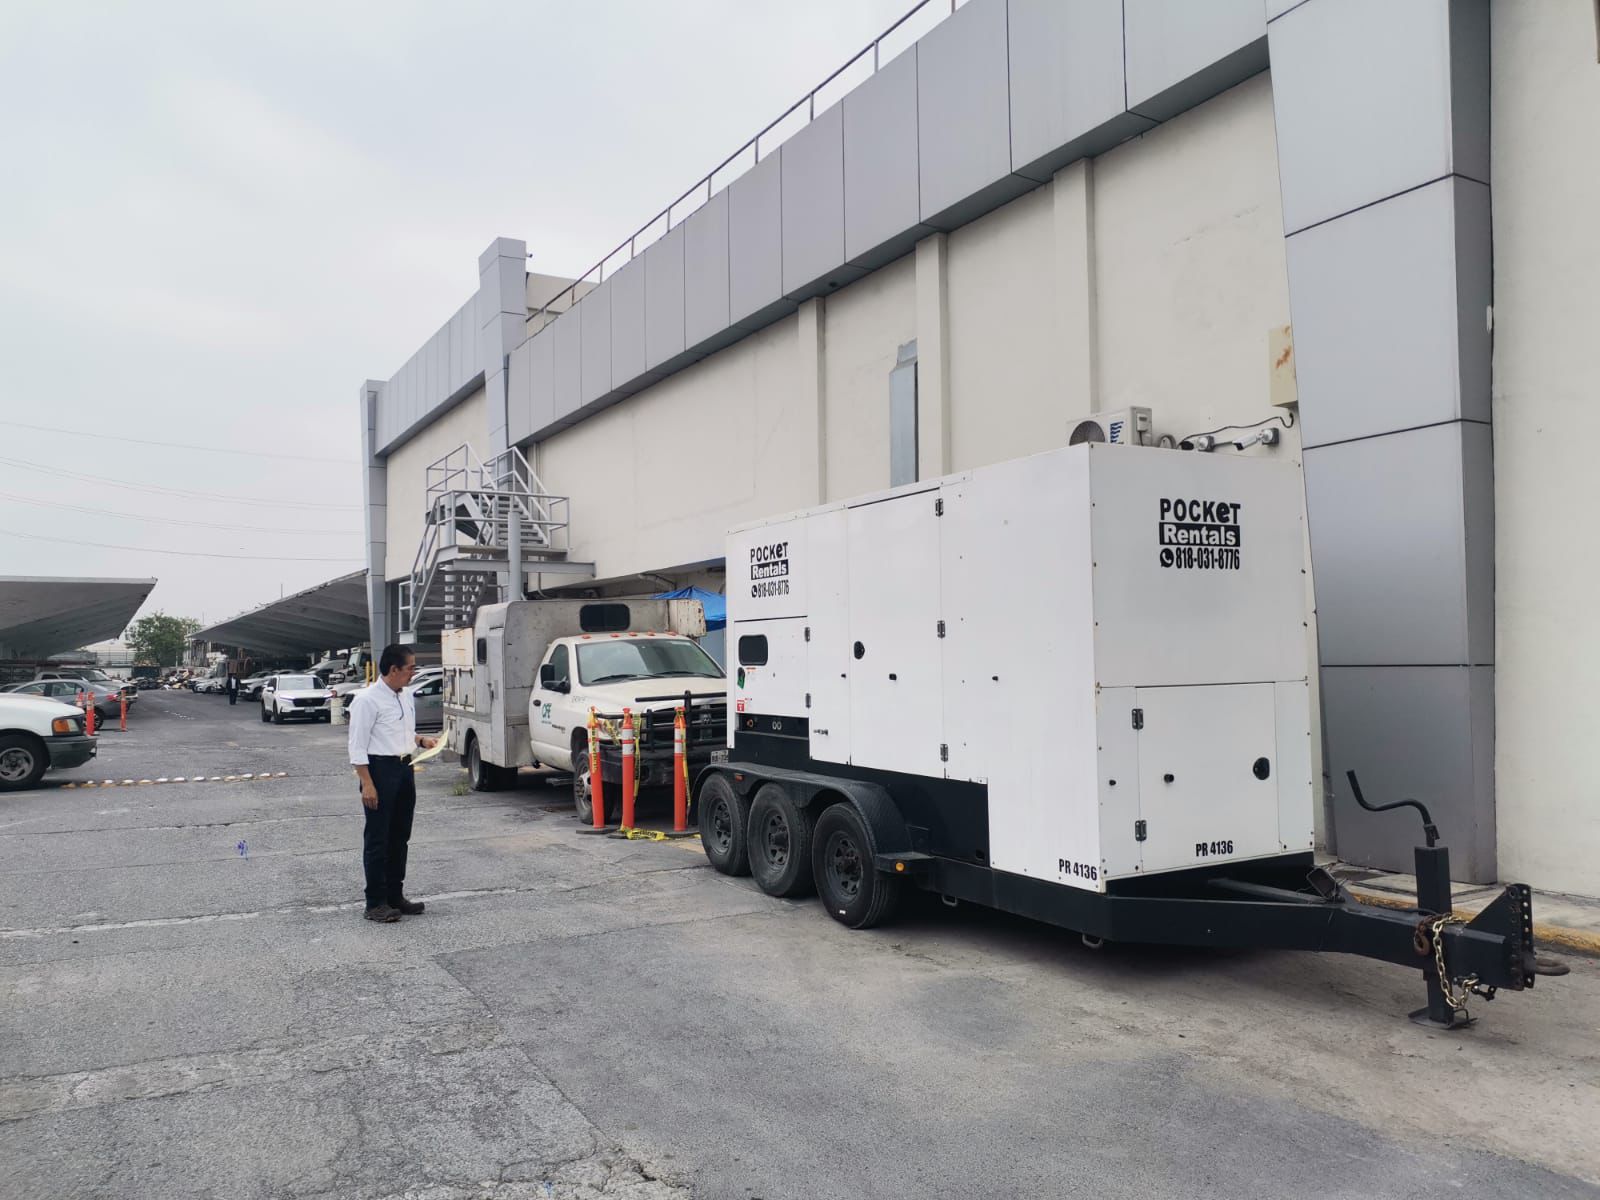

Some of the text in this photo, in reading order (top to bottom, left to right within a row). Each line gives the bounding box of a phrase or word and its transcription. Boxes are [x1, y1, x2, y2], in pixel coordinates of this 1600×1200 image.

[1163, 523, 1236, 546] Rentals
[1175, 547, 1240, 570] 818-031-8776
[752, 560, 787, 579] Rentals
[758, 579, 789, 598] 818-031-8776
[1194, 840, 1234, 857] PR 4136
[1058, 858, 1098, 881] PR 4136
